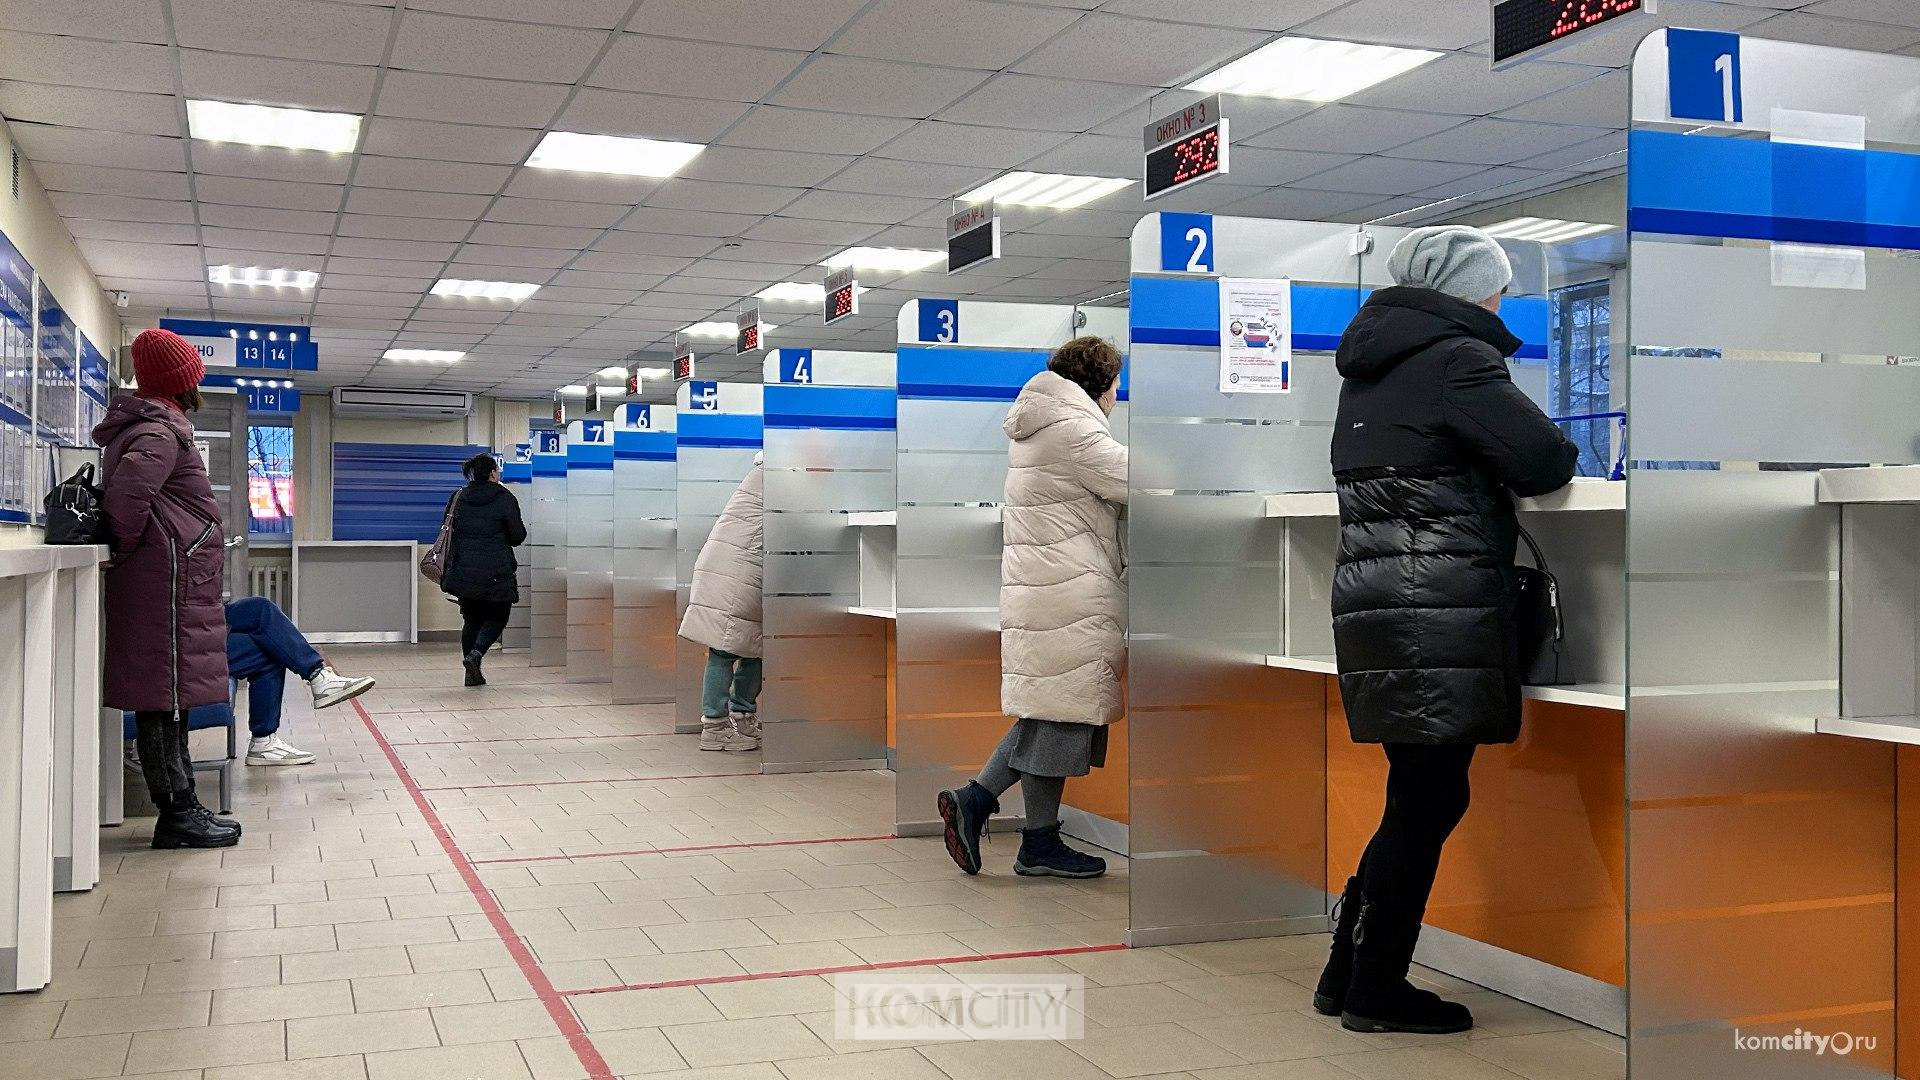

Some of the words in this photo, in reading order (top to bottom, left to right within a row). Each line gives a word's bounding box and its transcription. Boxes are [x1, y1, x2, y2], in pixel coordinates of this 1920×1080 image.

[1715, 54, 1734, 121] 1
[1157, 117, 1181, 142] ОКНО
[1183, 107, 1195, 131] №
[1199, 103, 1206, 123] 3
[1174, 131, 1218, 182] 292
[954, 213, 971, 231] ОКНО
[980, 205, 985, 220] 4
[1185, 227, 1208, 273] 2
[936, 309, 954, 343] 3
[243, 347, 259, 359] 13
[271, 348, 286, 361] 14
[793, 356, 810, 385] 4
[264, 394, 275, 405] 12
[703, 387, 716, 411] 5
[637, 409, 648, 429] 6
[549, 437, 558, 454] 8
[592, 425, 602, 443] 7
[524, 447, 532, 461] 9
